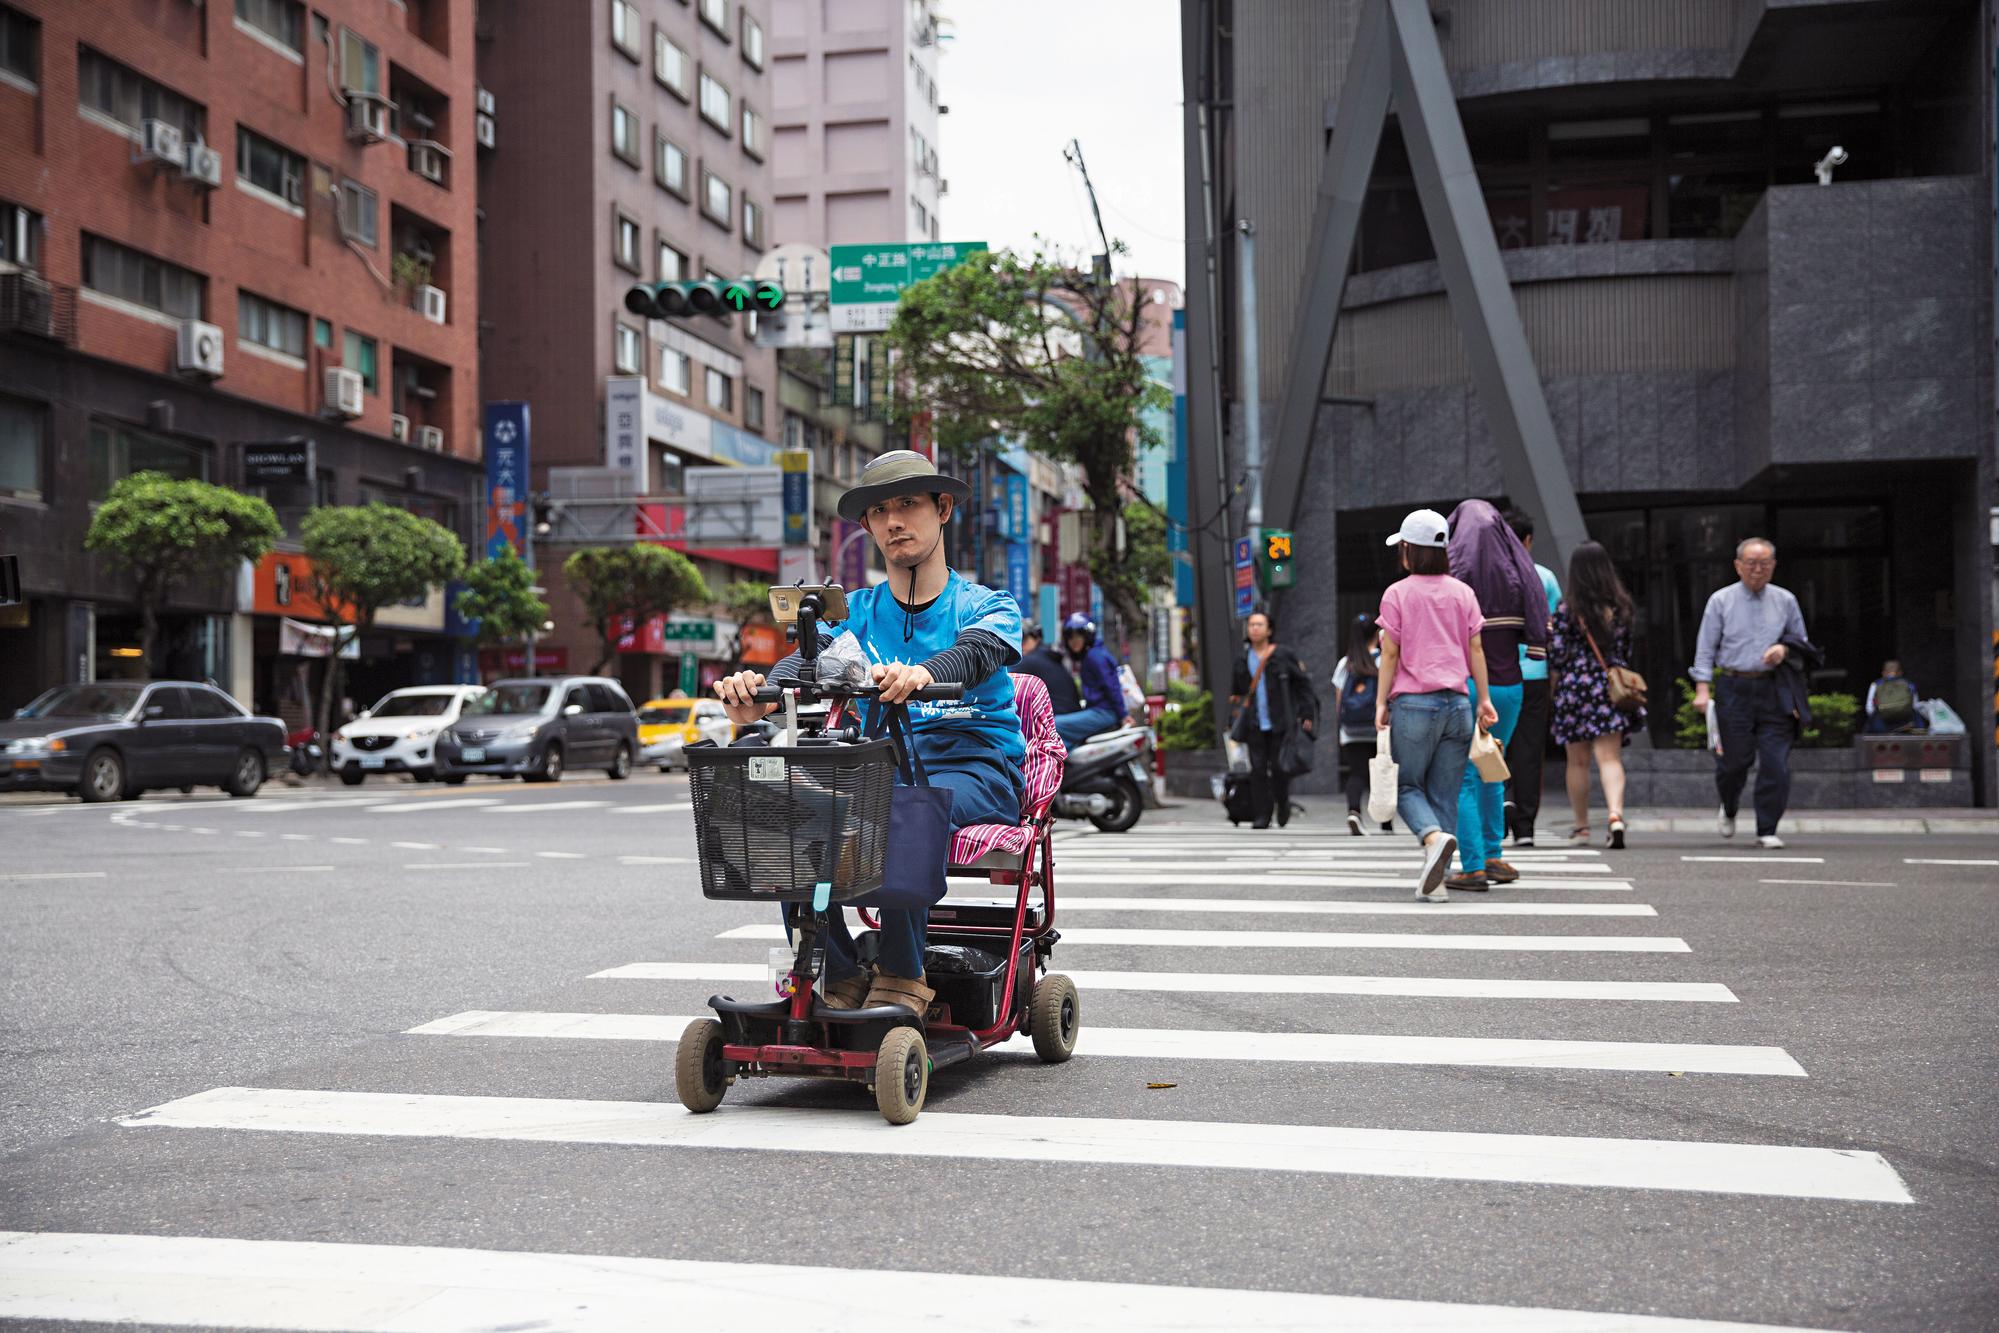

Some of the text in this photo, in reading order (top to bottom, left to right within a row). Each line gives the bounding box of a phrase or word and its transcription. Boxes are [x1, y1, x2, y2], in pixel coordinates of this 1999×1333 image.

[862, 252, 907, 267] 中正路
[911, 246, 956, 261] 中山路
[1268, 536, 1291, 559] 24
